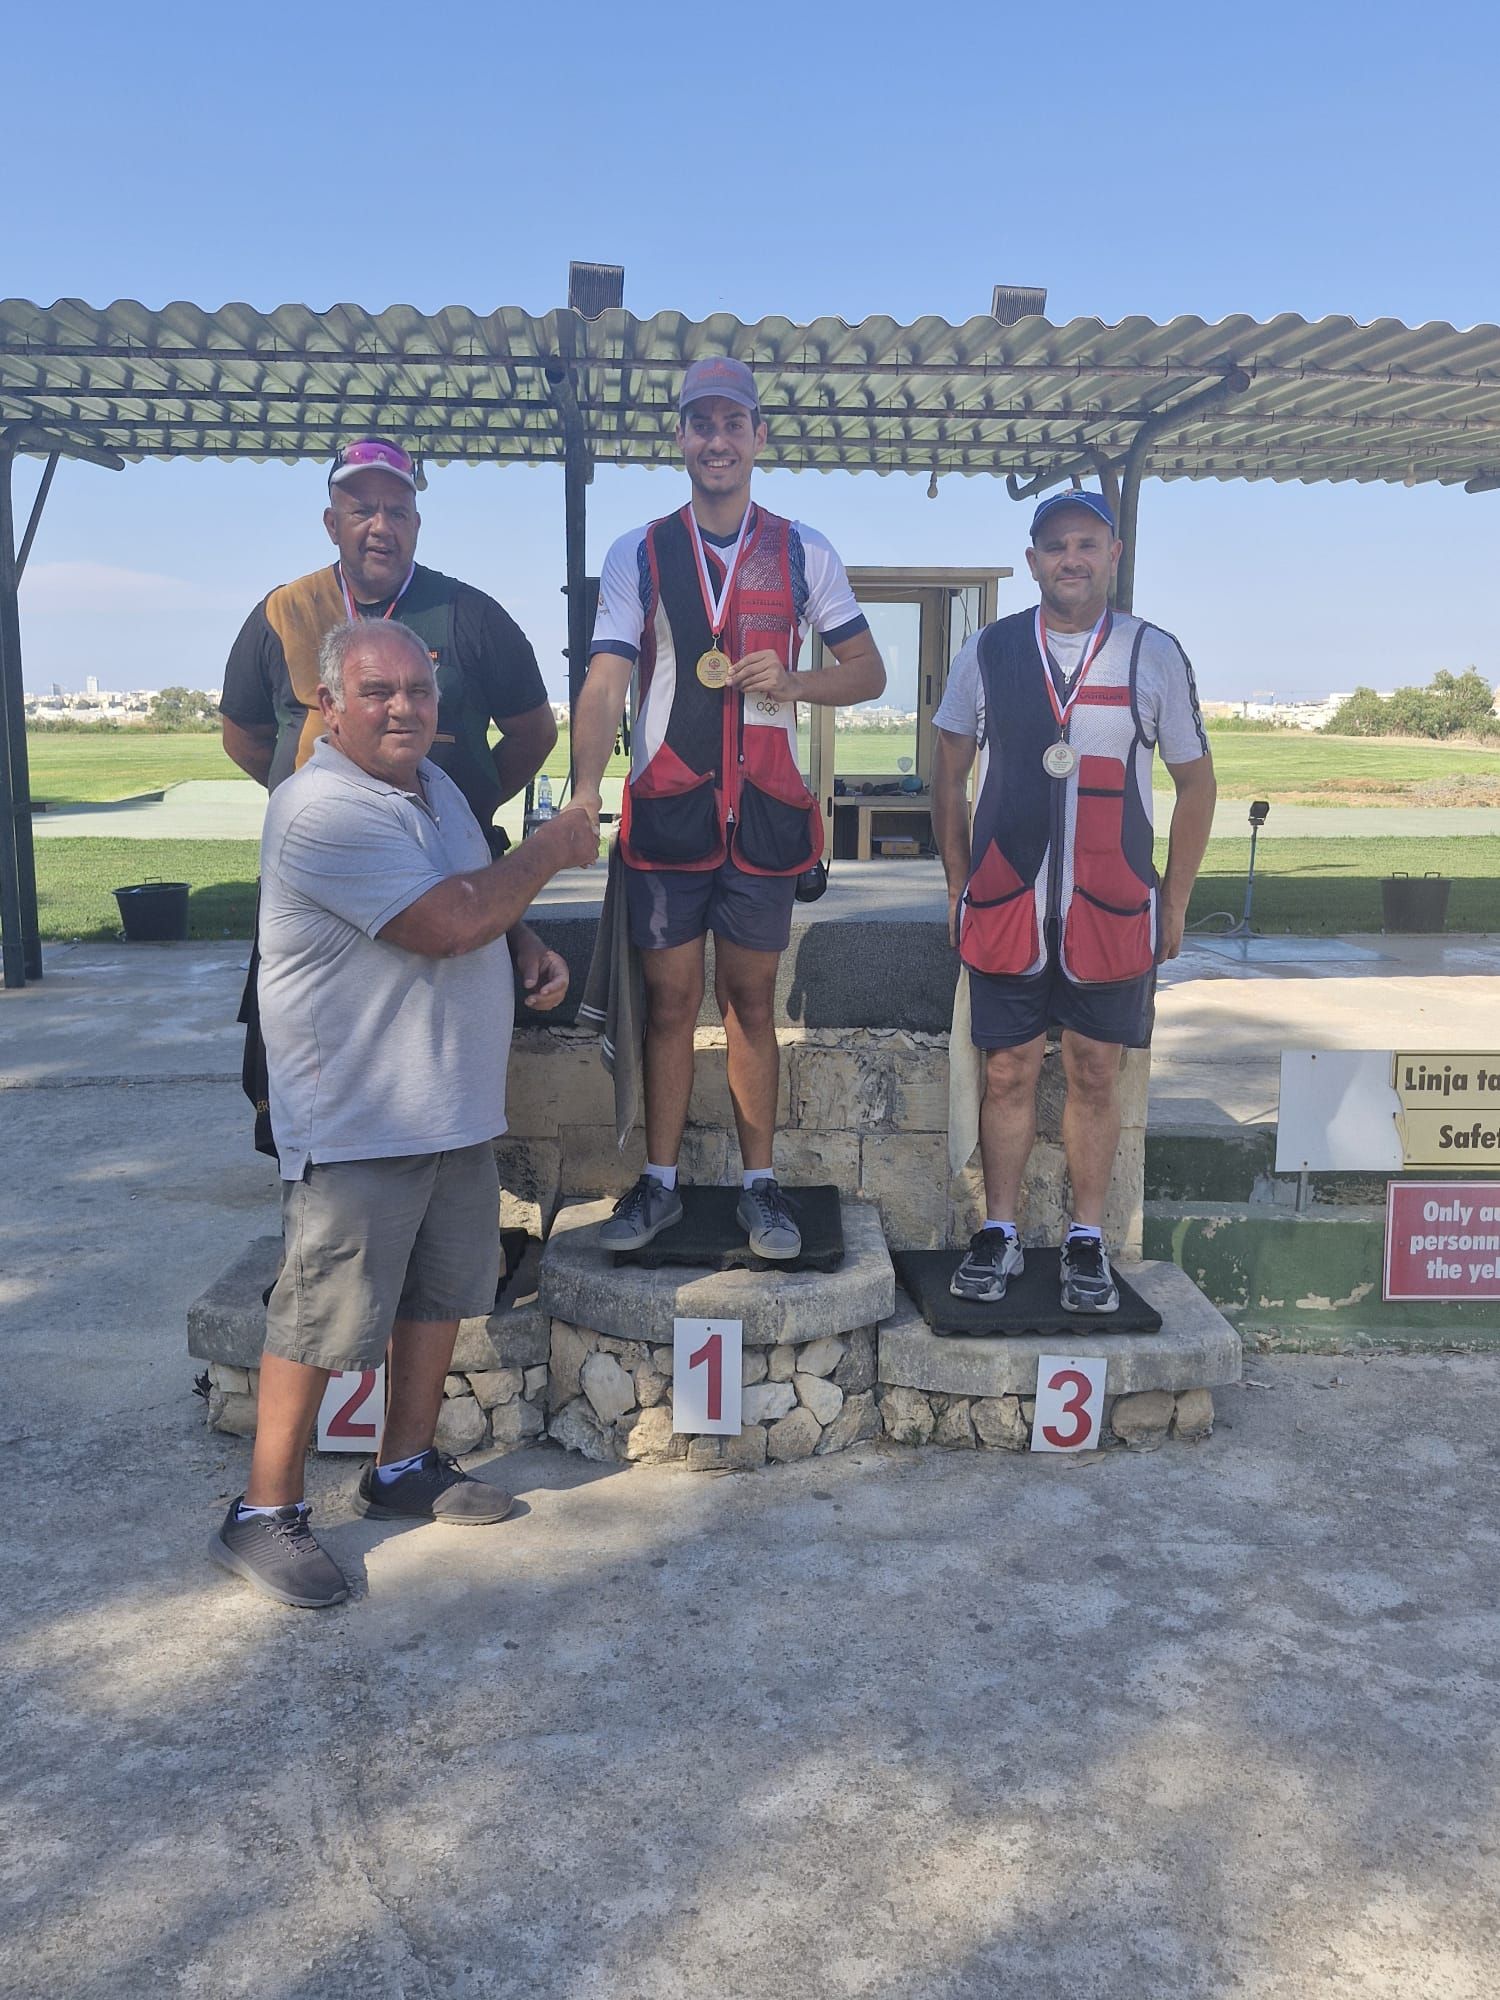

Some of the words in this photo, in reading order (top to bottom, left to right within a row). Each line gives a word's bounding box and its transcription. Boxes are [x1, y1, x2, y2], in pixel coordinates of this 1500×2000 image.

[1405, 1065, 1468, 1096] Linja
[1477, 1069, 1500, 1091] ta
[1423, 1200, 1473, 1226] Only
[1410, 1235, 1500, 1255] personn
[1427, 1257, 1463, 1279] the
[1468, 1257, 1500, 1283] yel
[689, 1334, 722, 1420] 1
[326, 1369, 377, 1437] 2
[1042, 1370, 1093, 1448] 3
